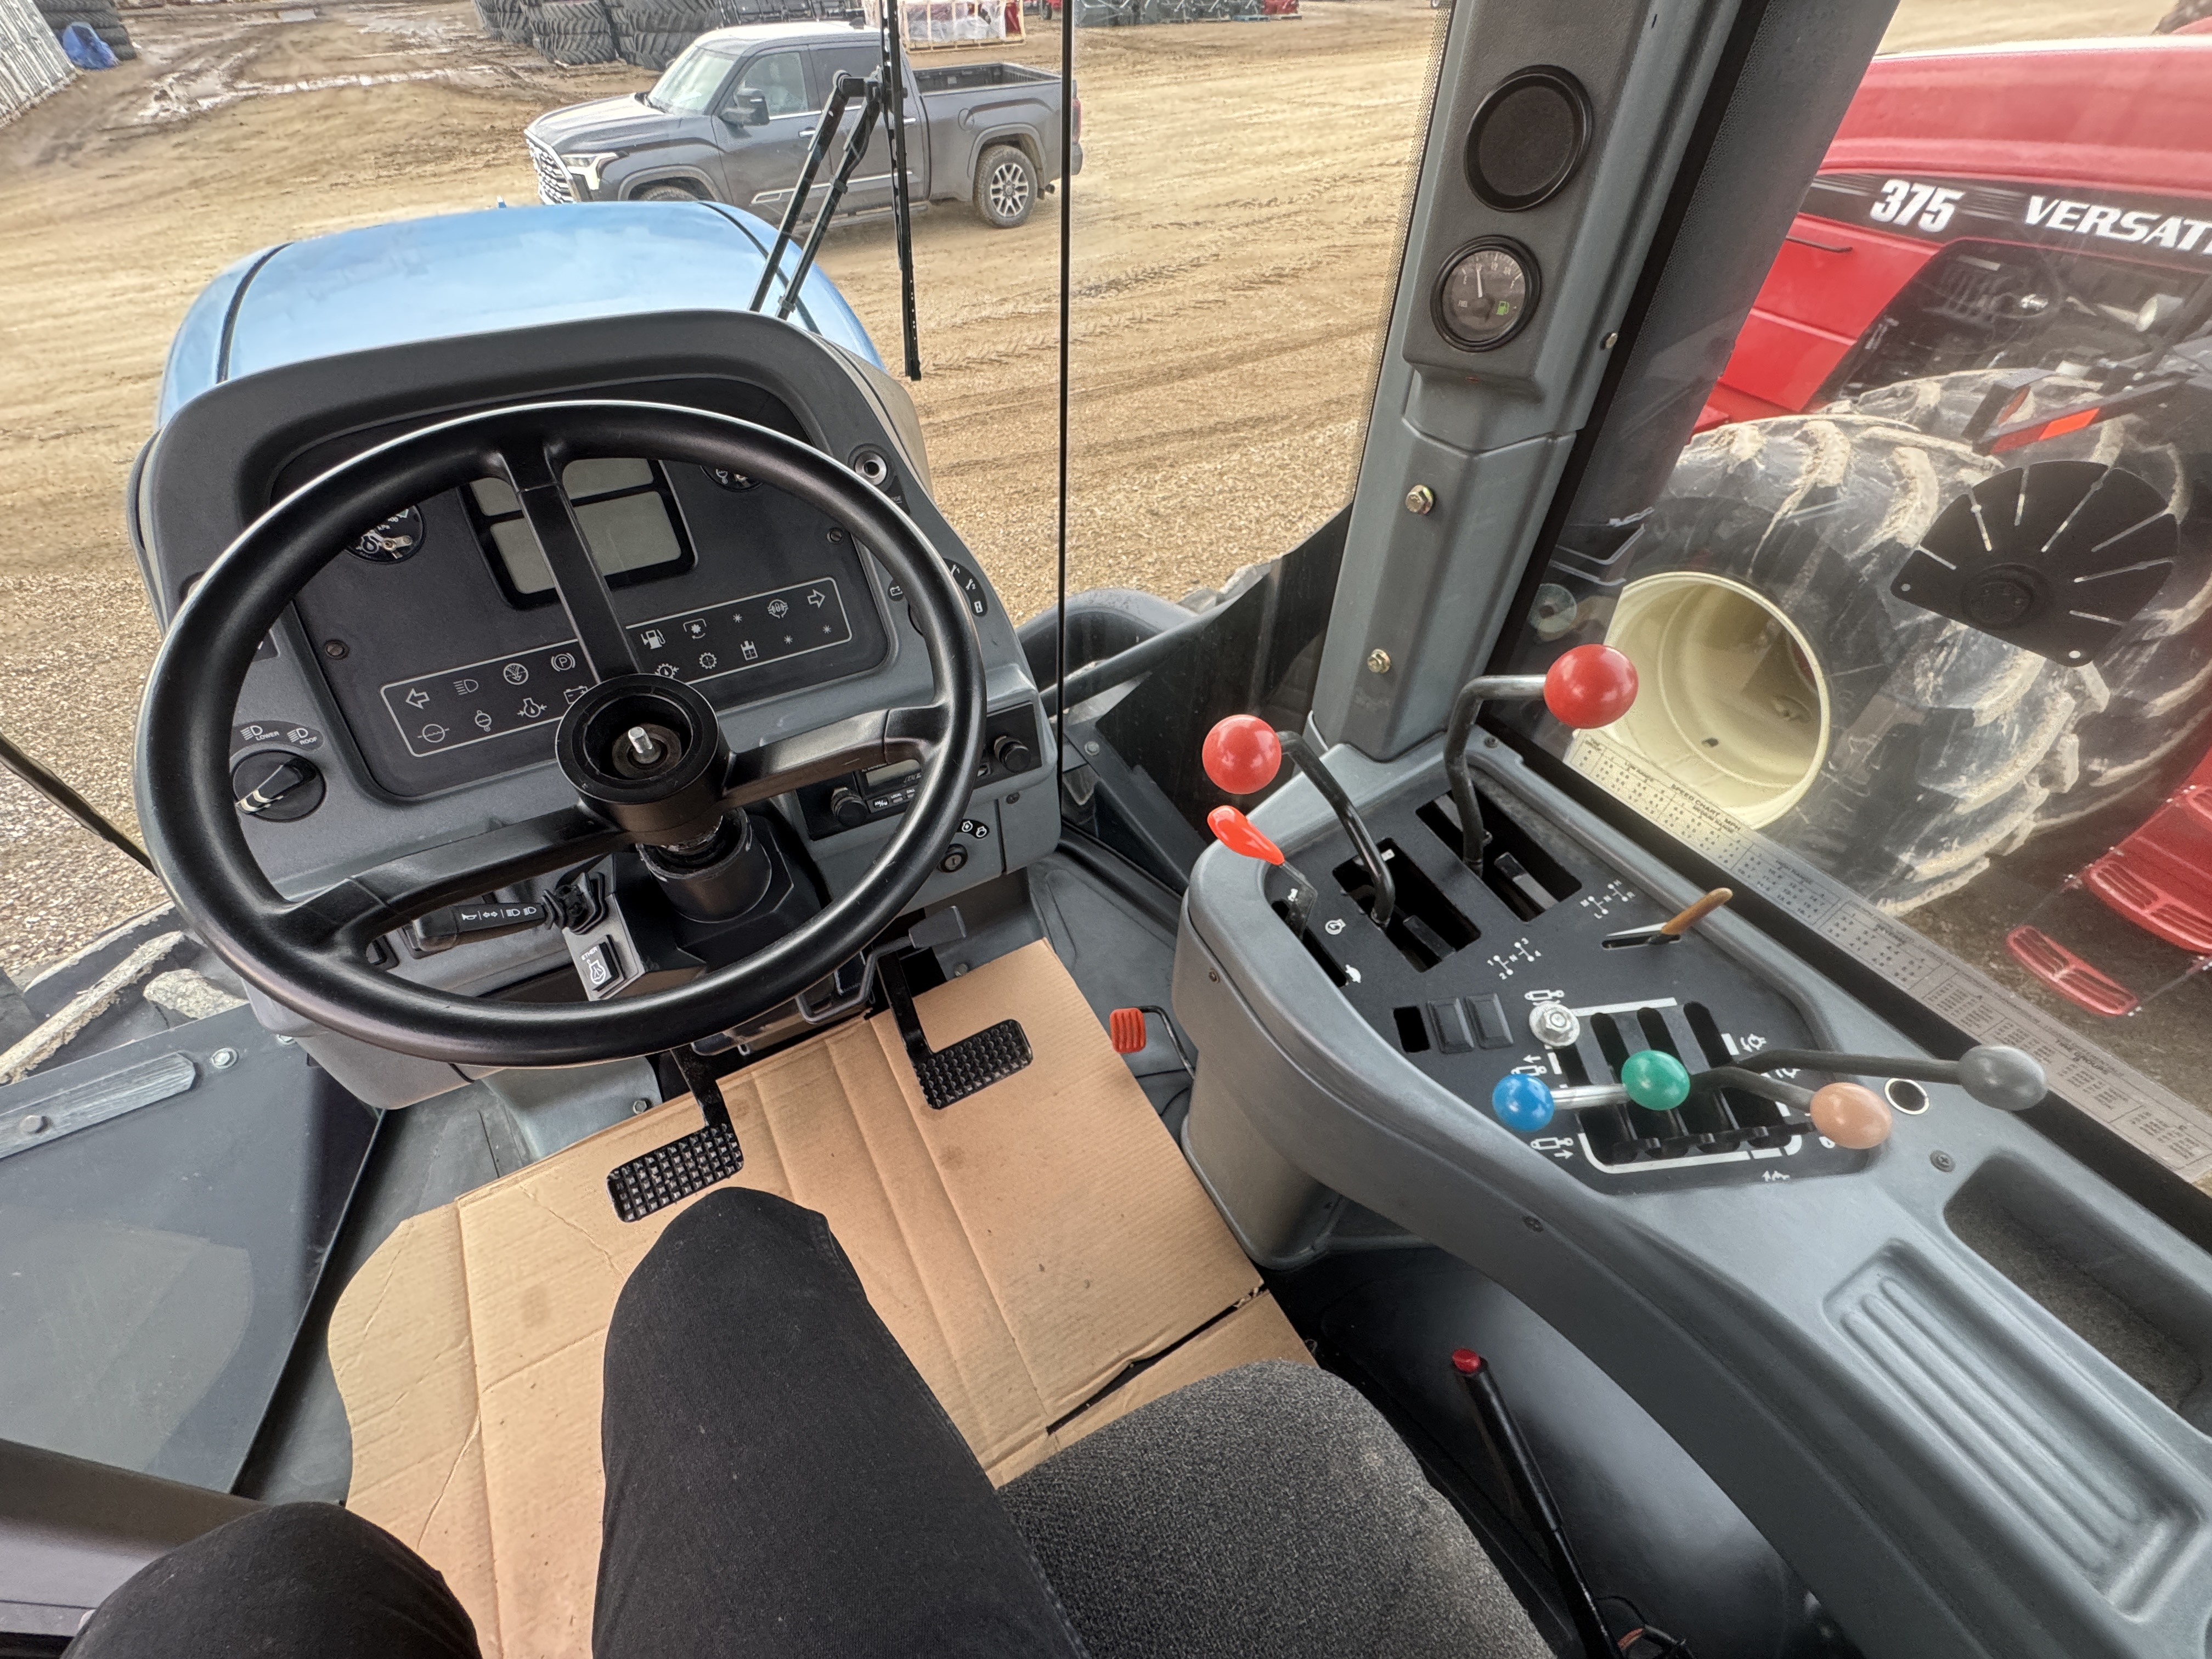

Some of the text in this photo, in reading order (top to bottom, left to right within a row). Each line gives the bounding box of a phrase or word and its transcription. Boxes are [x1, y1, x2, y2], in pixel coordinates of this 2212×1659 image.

[1870, 179, 1966, 233] 375
[255, 731, 280, 741] LOWER
[299, 736, 318, 745] ROOF
[1671, 783, 1741, 831] SPEED CHART MPH
[581, 946, 598, 961] ETHER
[1509, 954, 1518, 962] N
